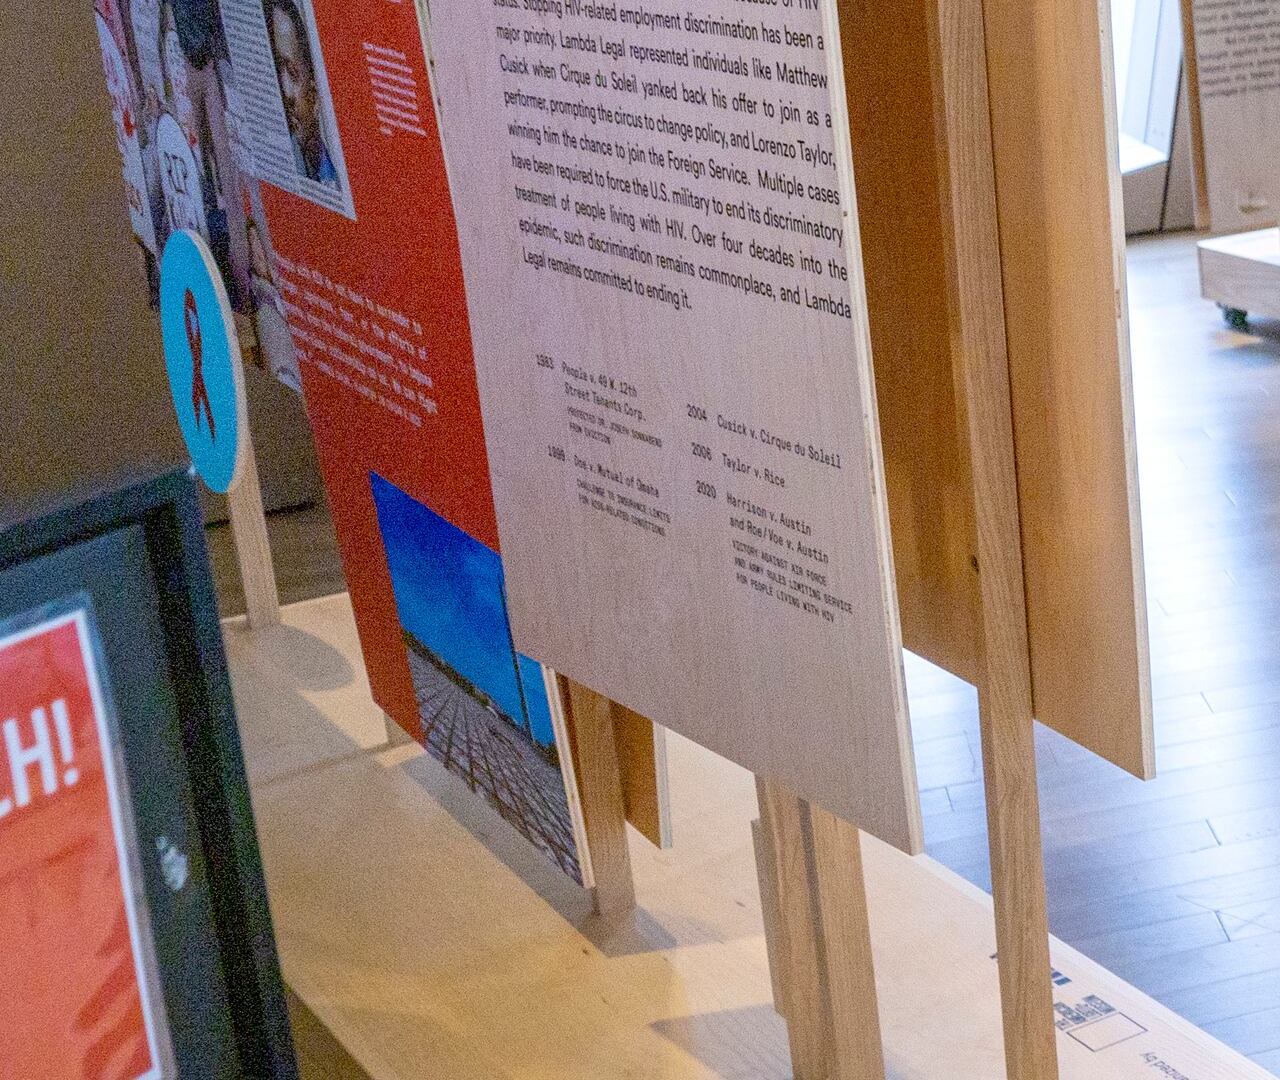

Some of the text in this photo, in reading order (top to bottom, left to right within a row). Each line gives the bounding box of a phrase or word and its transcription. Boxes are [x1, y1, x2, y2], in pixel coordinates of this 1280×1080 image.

[495, 25, 521, 45] major
[558, 30, 598, 54] Lambda
[598, 35, 627, 62] Legal
[628, 44, 690, 68] represented
[691, 48, 750, 78] individuals
[751, 56, 773, 82] like
[775, 61, 829, 90] Matthew
